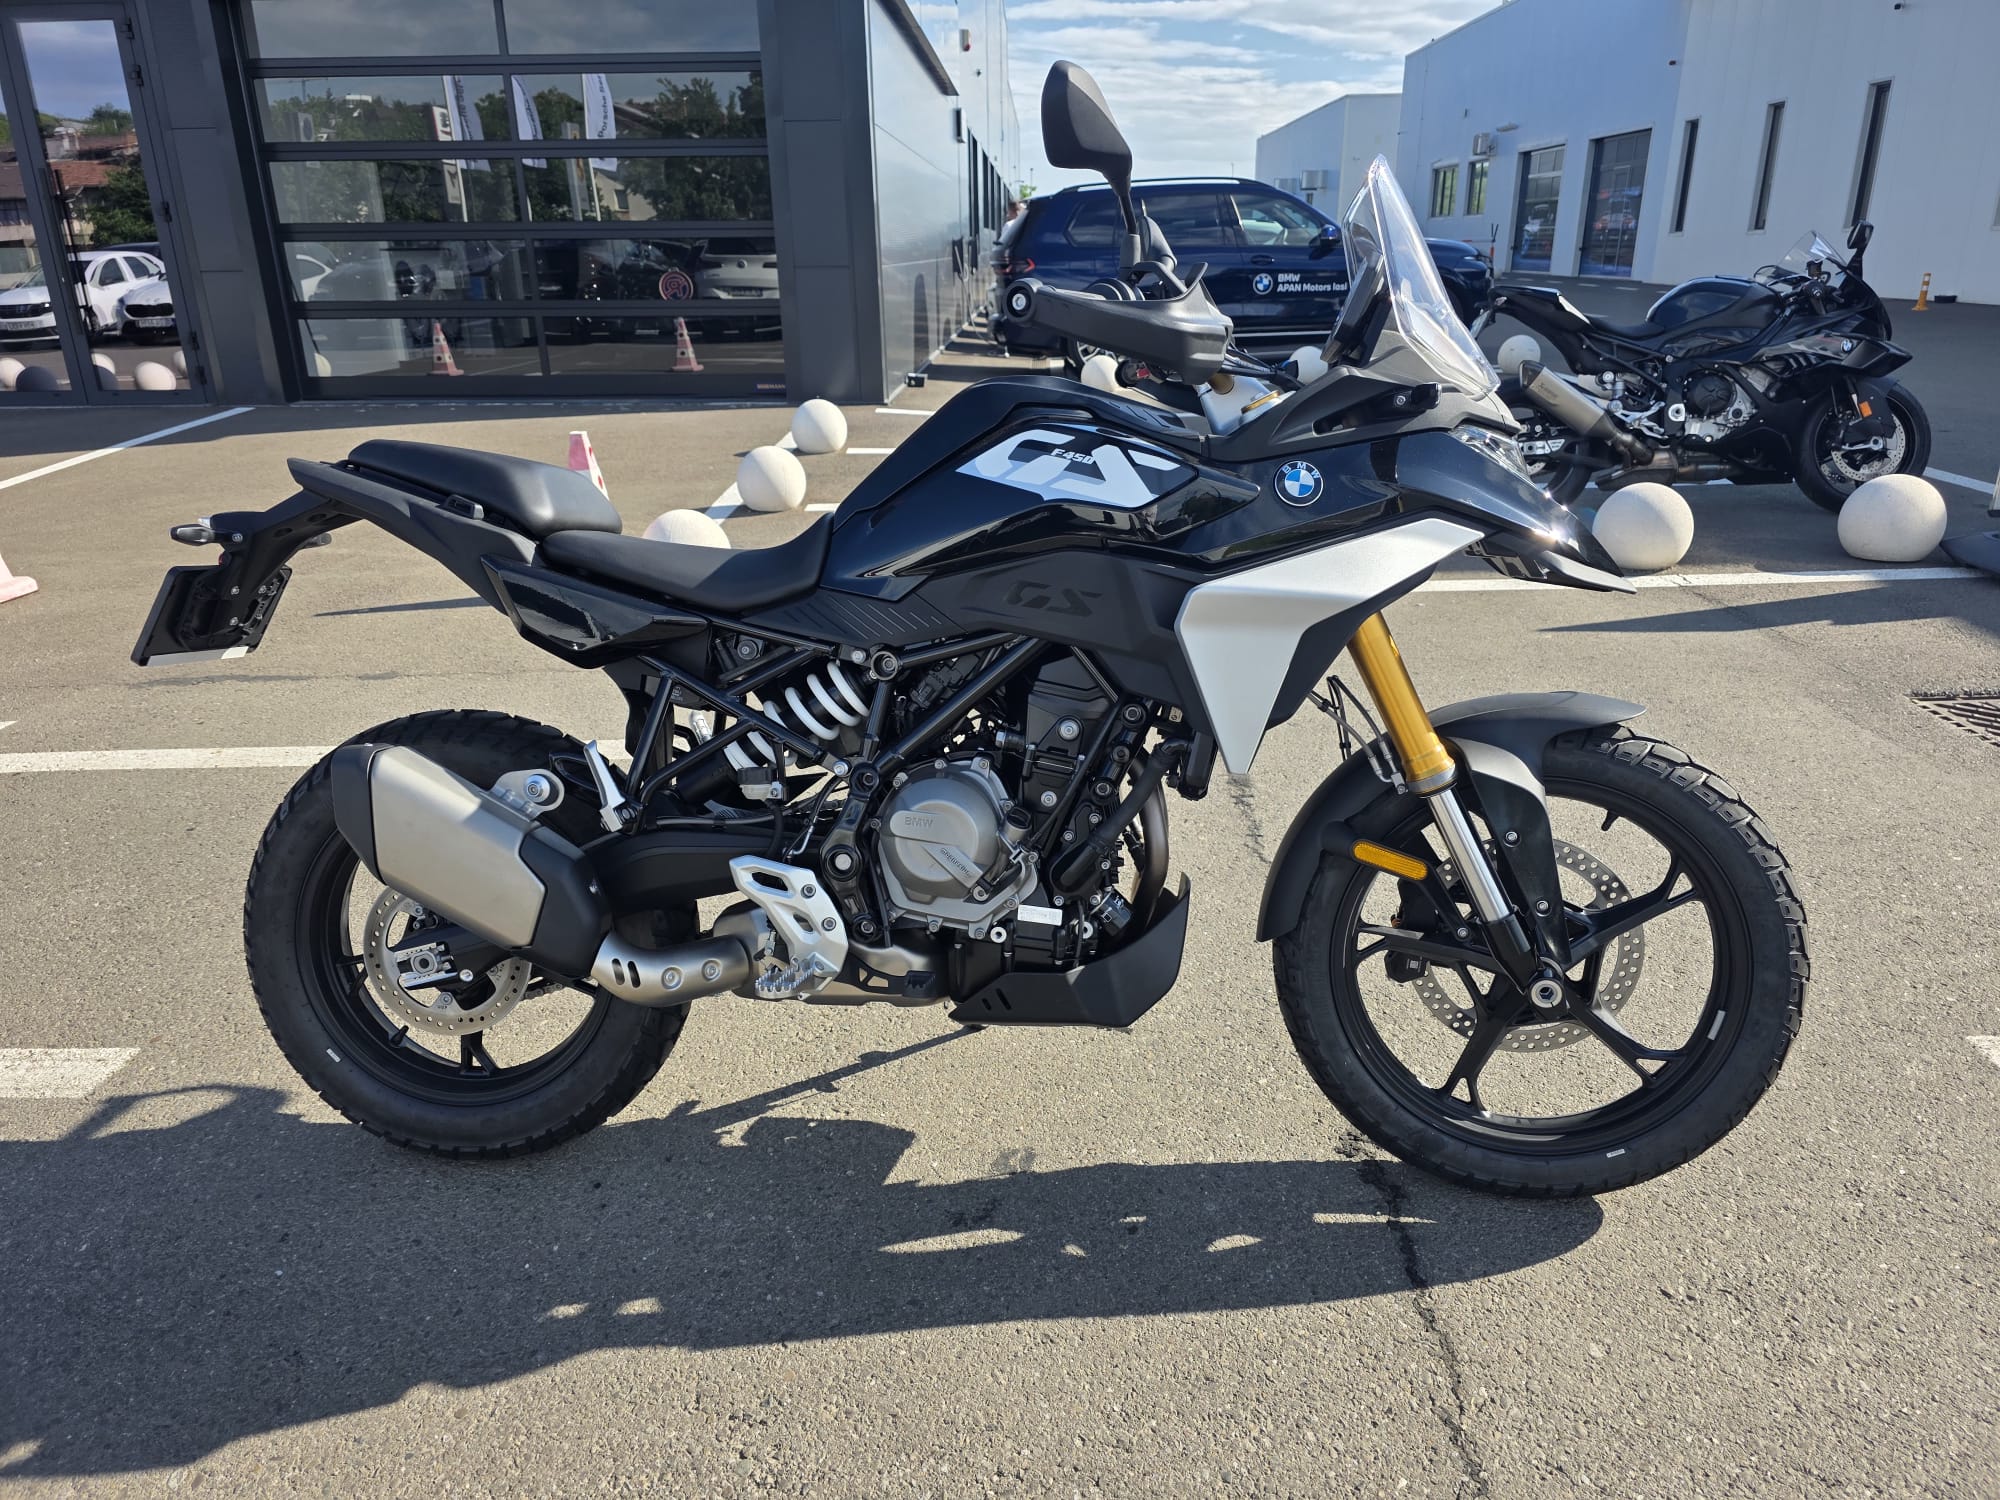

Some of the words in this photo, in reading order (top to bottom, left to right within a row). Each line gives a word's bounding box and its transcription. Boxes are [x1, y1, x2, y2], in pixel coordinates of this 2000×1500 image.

[1278, 273, 1301, 282] BMW
[1277, 283, 1301, 292] APAN
[1303, 282, 1331, 291] Motors
[975, 429, 1181, 508] GS
[1281, 462, 1321, 479] BMW
[904, 816, 934, 828] BMW
